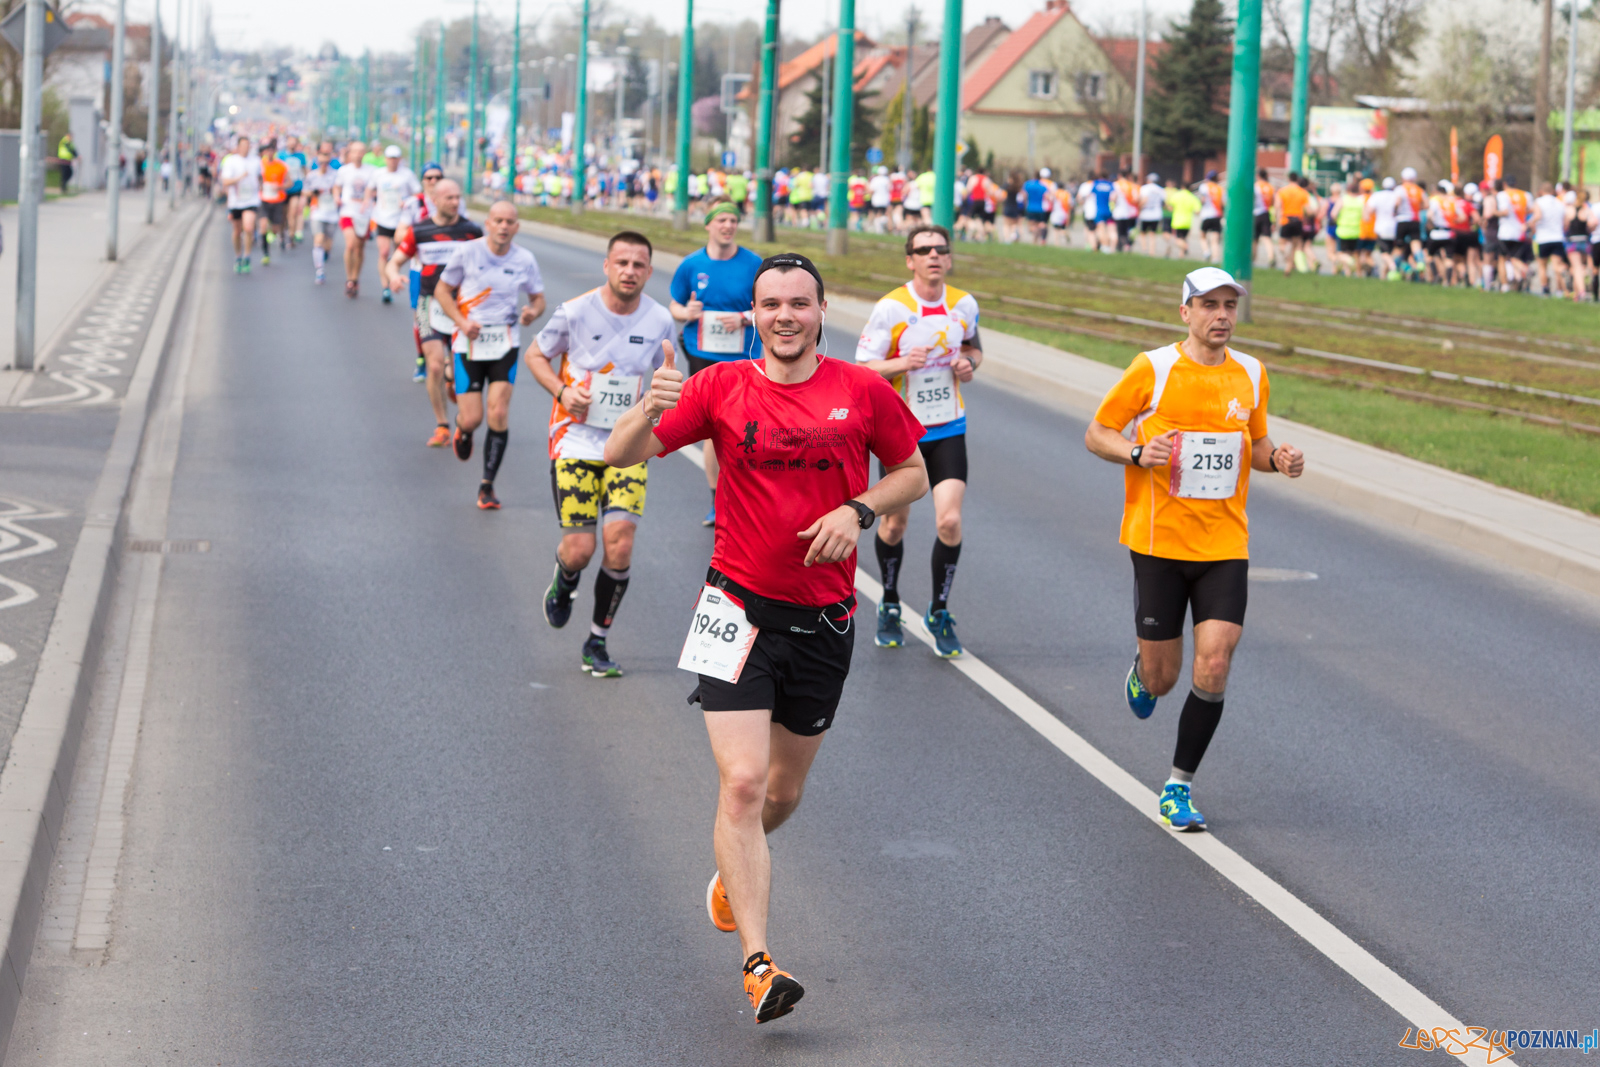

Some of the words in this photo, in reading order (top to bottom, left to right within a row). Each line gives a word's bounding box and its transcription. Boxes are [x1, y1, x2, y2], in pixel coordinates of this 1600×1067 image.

[599, 391, 632, 406] 7138
[917, 387, 950, 403] 5355
[769, 441, 816, 449] FESTIWAL
[771, 434, 848, 443] TRANSGRANICZNY
[1192, 453, 1233, 470] 2138
[693, 613, 739, 643] 1948
